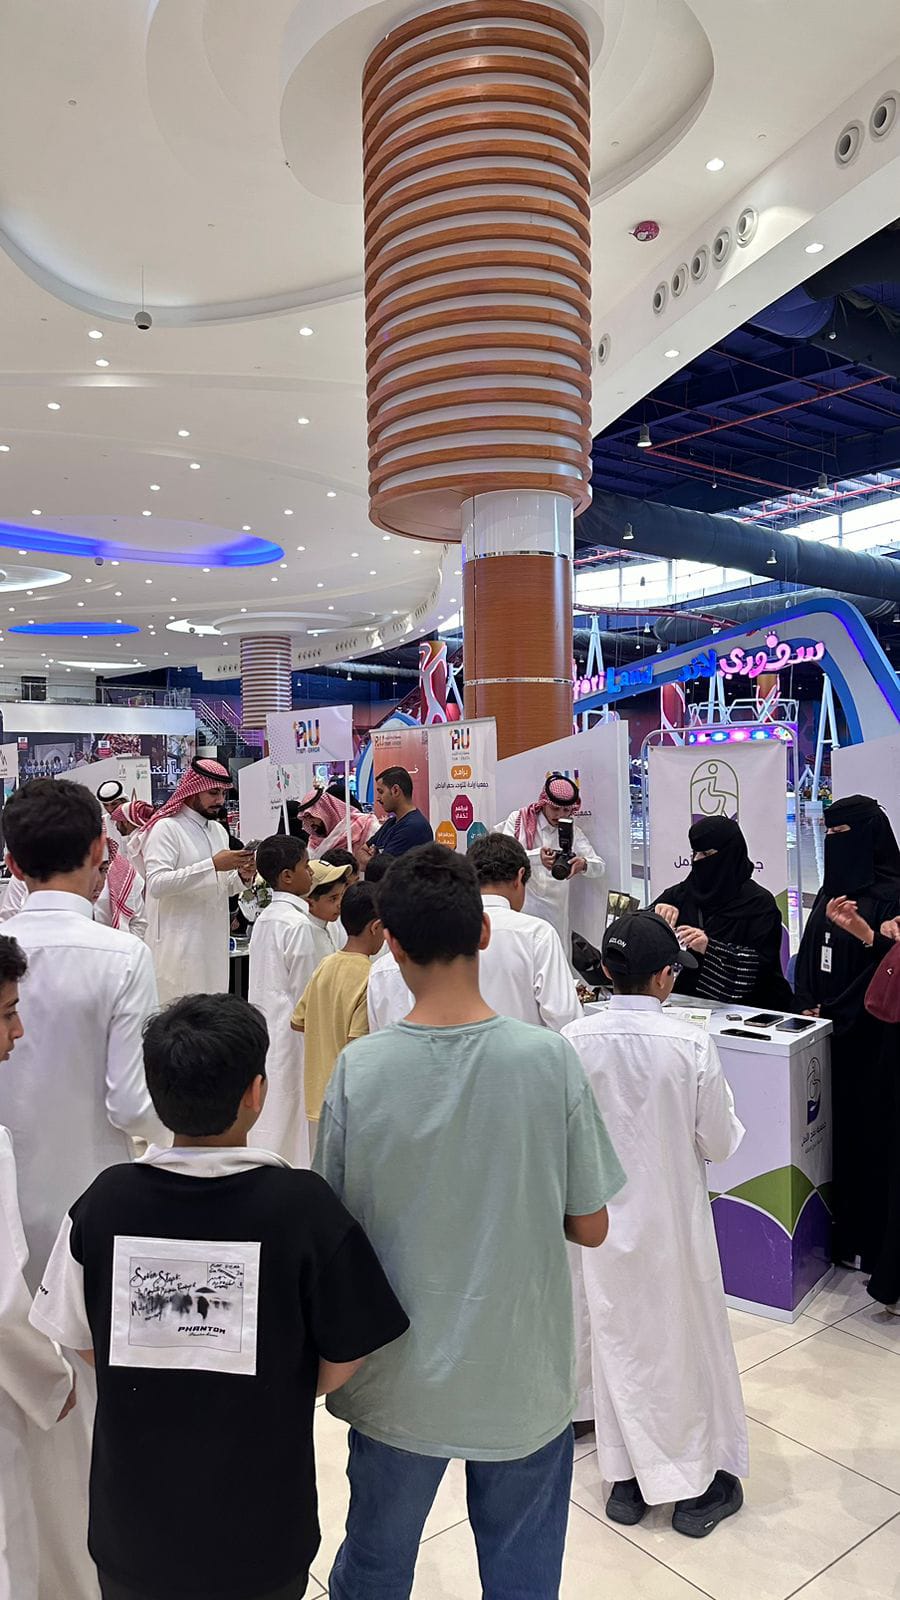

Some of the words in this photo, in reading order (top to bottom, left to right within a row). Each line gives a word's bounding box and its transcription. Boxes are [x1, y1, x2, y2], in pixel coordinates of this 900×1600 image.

[719, 631, 824, 679] سفوري
[607, 664, 653, 694] Land
[177, 1325, 226, 1335] PHANTOM
